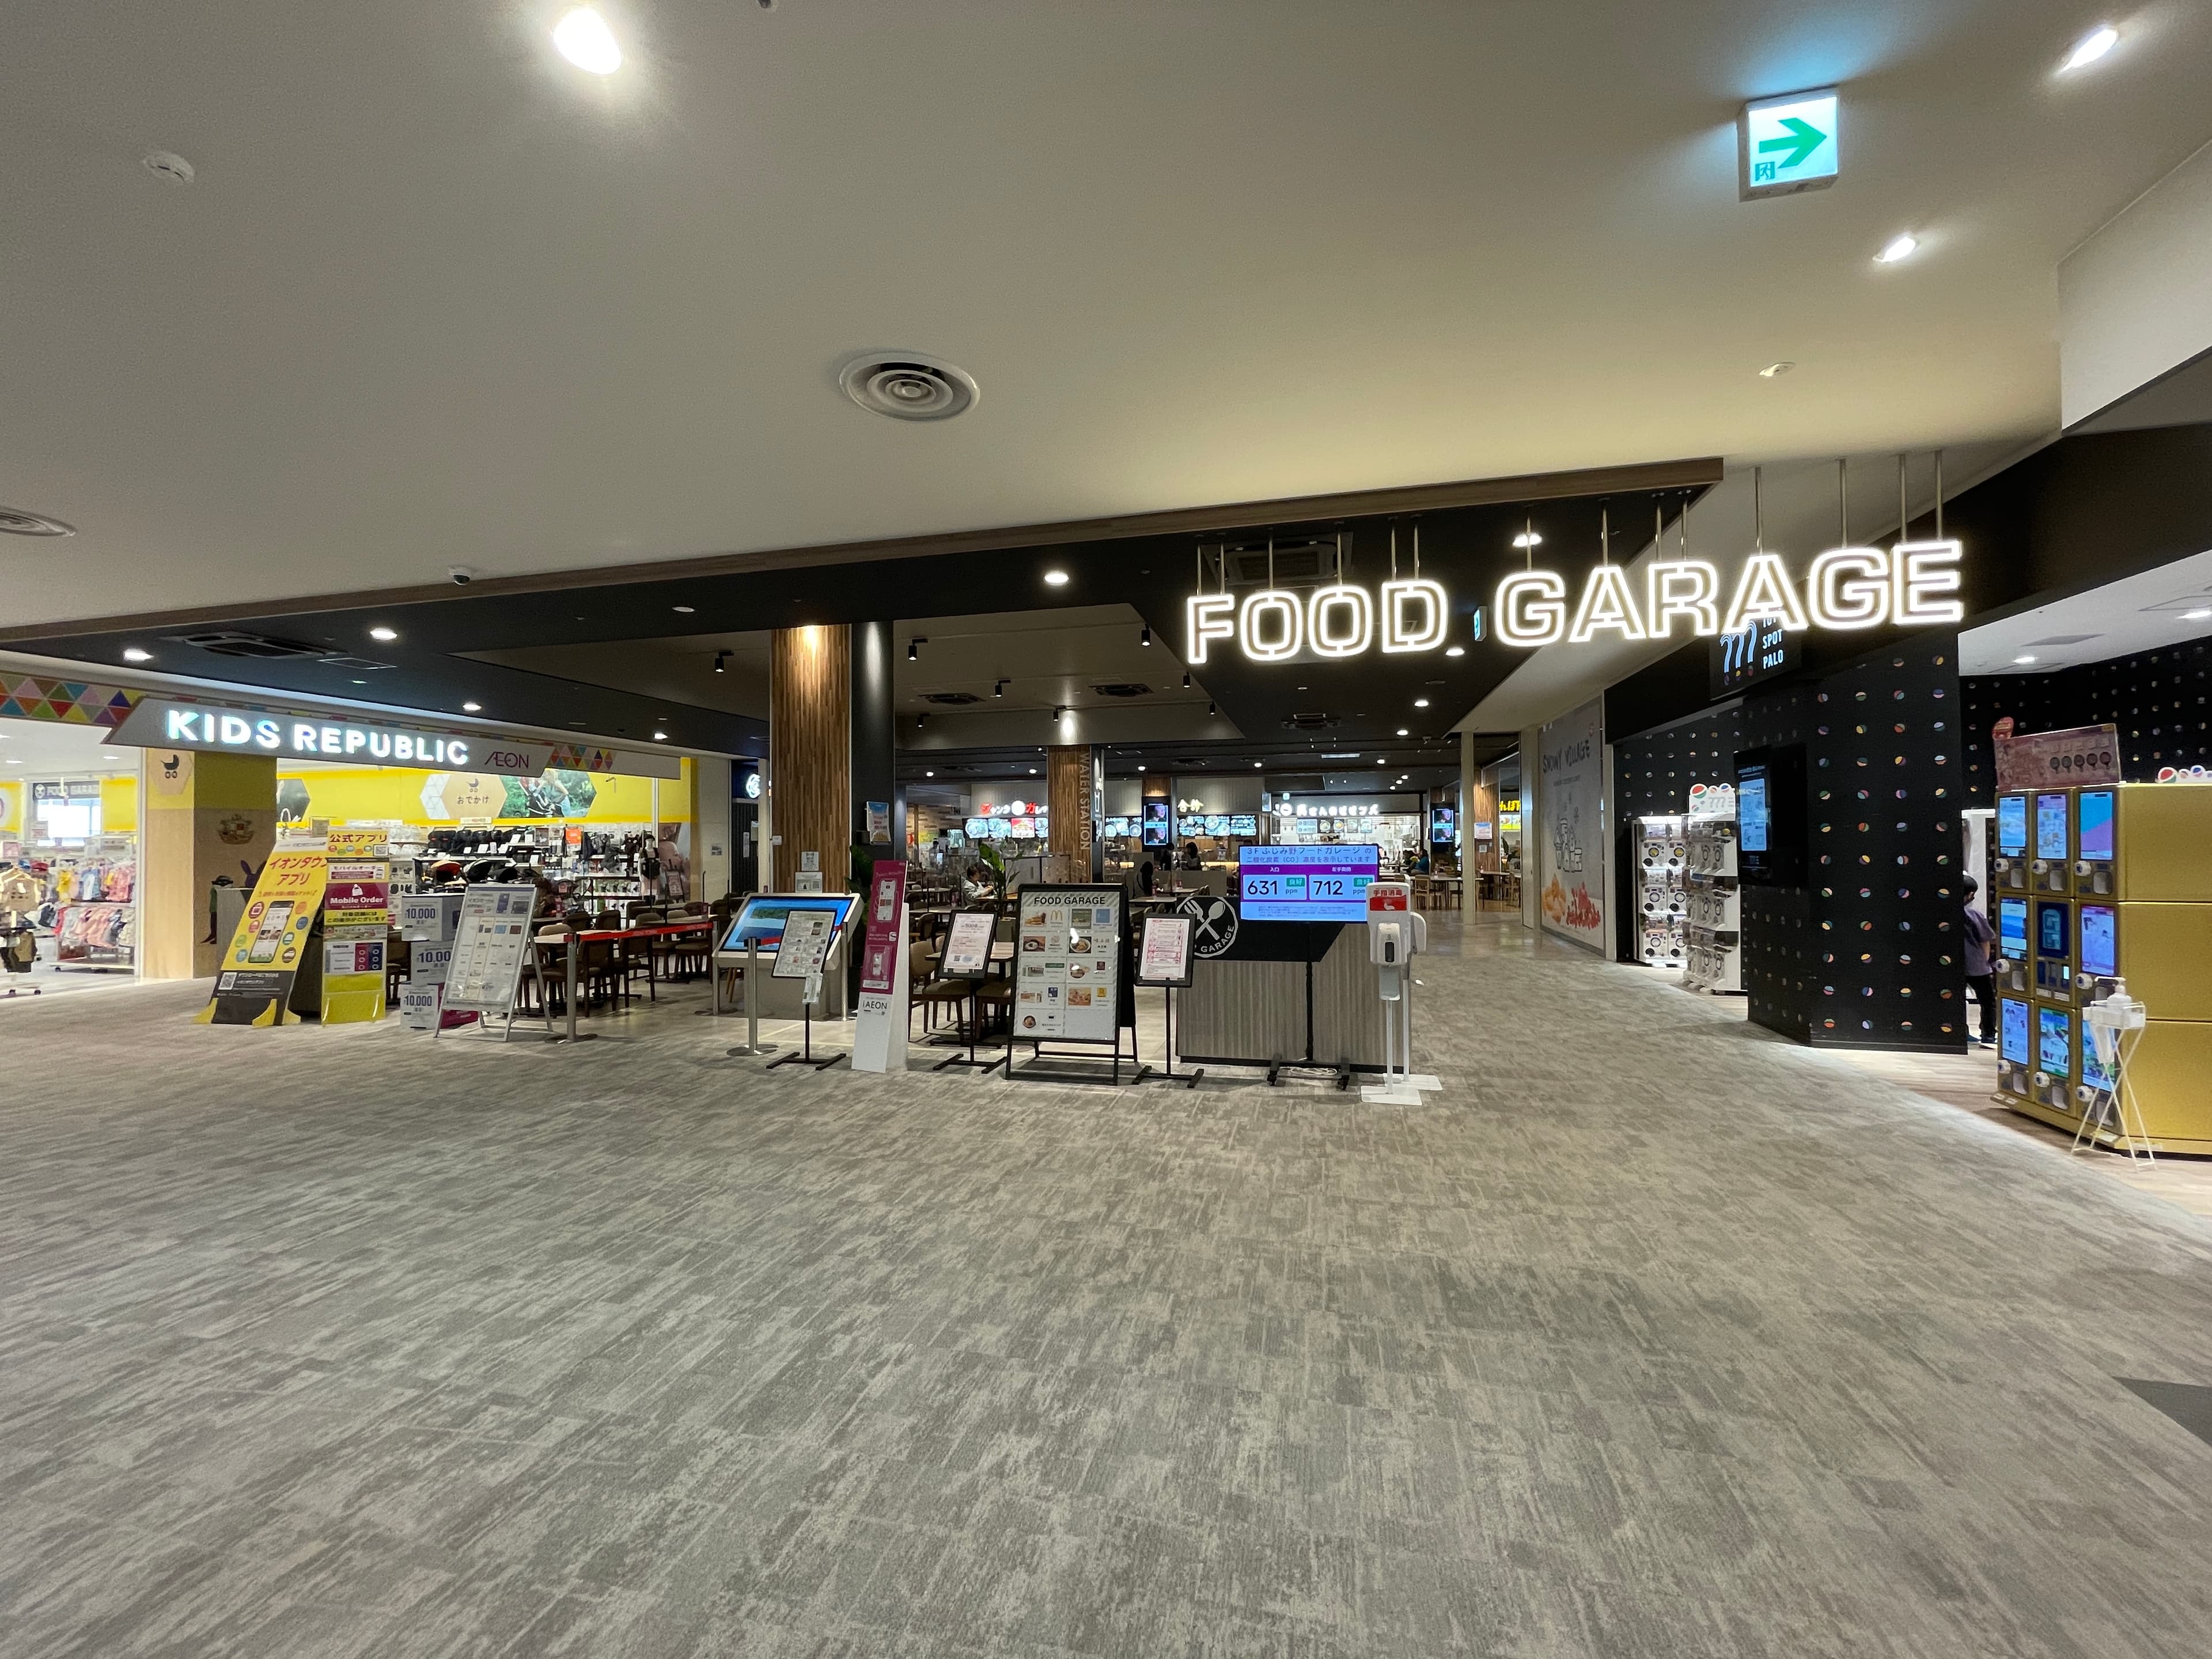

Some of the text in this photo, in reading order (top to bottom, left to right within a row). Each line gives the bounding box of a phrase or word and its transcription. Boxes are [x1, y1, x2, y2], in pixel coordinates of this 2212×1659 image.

[1185, 540, 1963, 664] FOOD GARAGE
[1763, 628, 1783, 649] SPOT
[1763, 649, 1783, 669] PALO
[168, 710, 470, 765] KIDS REPUBLIC
[457, 796, 489, 805] おでかけ
[1079, 753, 1090, 850] WATER STATION
[329, 834, 388, 843] 公式アプリ
[277, 872, 310, 885] アプリ
[1247, 880, 1278, 895] 631
[1313, 880, 1343, 895] 712
[1034, 896, 1105, 904] FOOD GARAGE
[406, 908, 436, 919] 10,000
[1200, 925, 1234, 953] GARAGE
[404, 995, 433, 1007] 10,000
